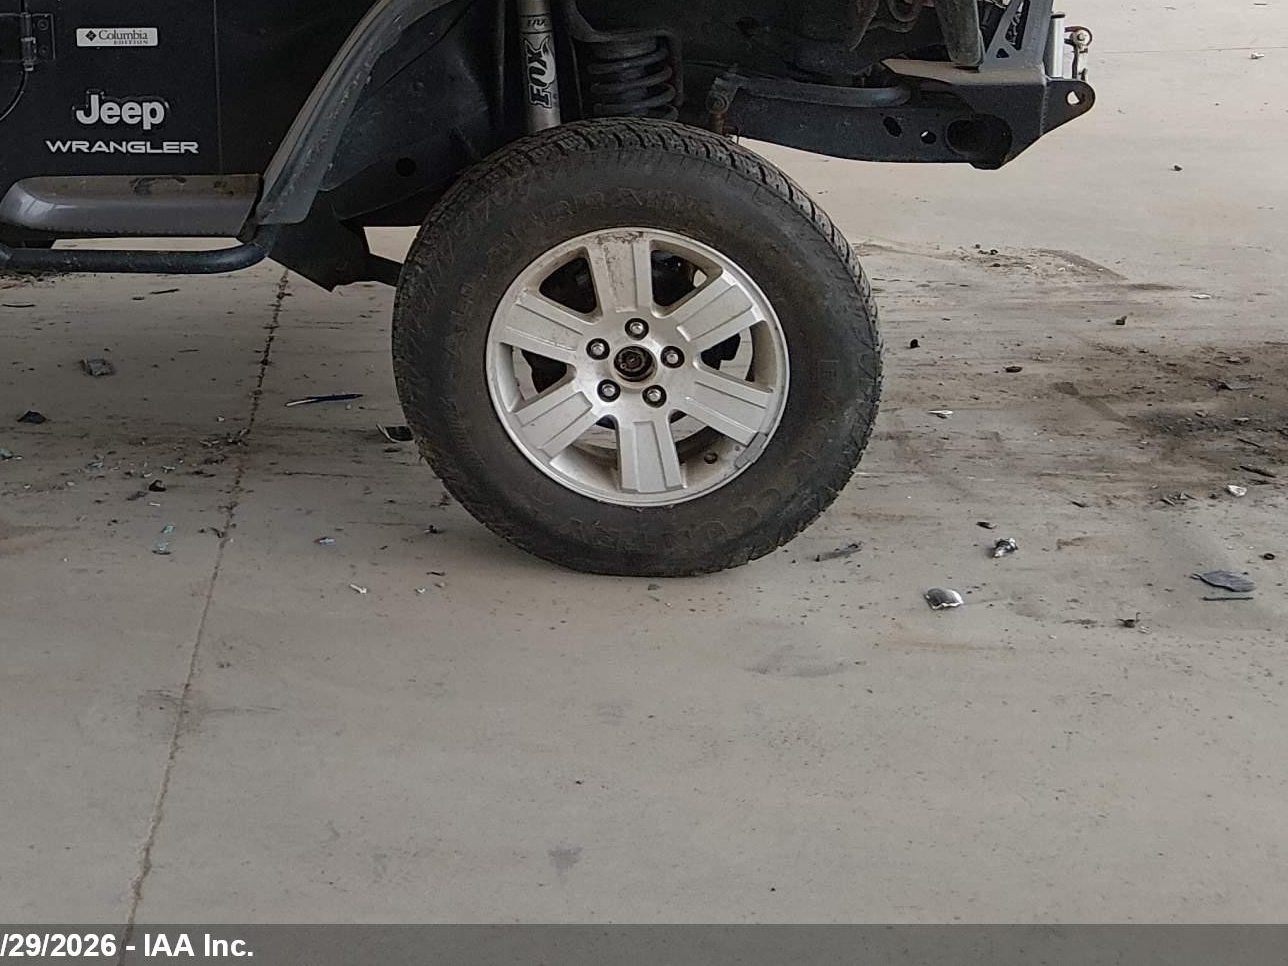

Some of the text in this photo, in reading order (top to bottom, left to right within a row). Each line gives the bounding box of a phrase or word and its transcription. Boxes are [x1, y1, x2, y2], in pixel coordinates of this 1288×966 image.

[98, 29, 148, 41] Columbia
[524, 36, 553, 108] FOX
[76, 94, 165, 129] Jeep
[45, 140, 199, 153] WRANGLER
